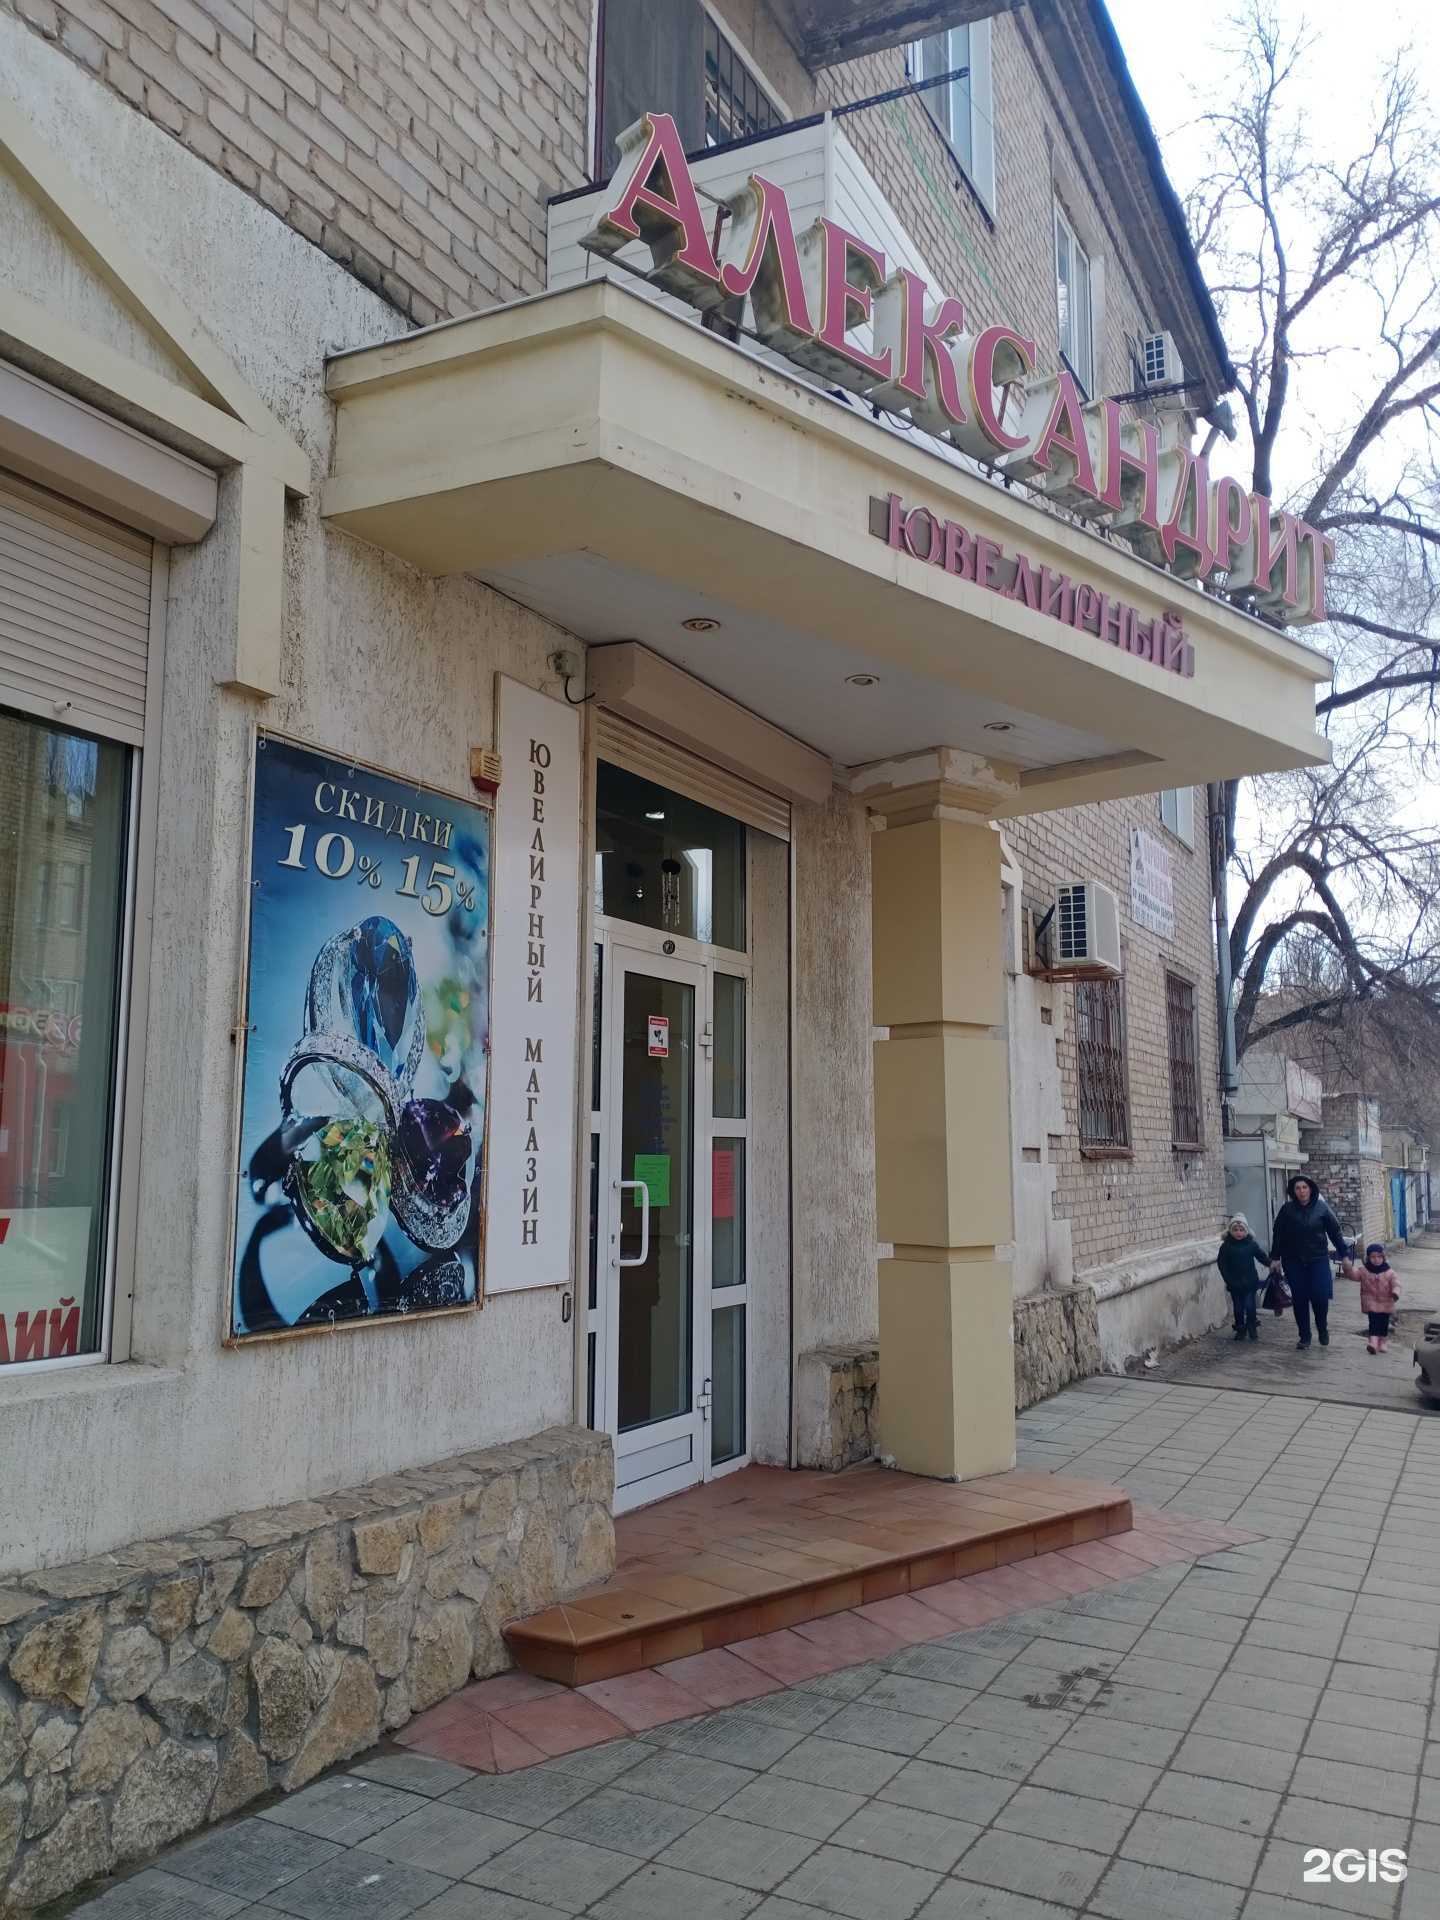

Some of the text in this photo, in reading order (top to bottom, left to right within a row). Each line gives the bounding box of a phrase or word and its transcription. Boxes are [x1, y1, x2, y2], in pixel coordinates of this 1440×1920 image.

[607, 111, 1336, 622] АЛЕКСАНДРИТ
[887, 492, 1194, 680] ЮВЕЛИРНЫЙ
[277, 823, 476, 917] 10% 15%
[314, 781, 454, 849] СКИДКИ
[520, 738, 552, 1246] ЮВЕЛИРНЫЙ МАГАЗИН
